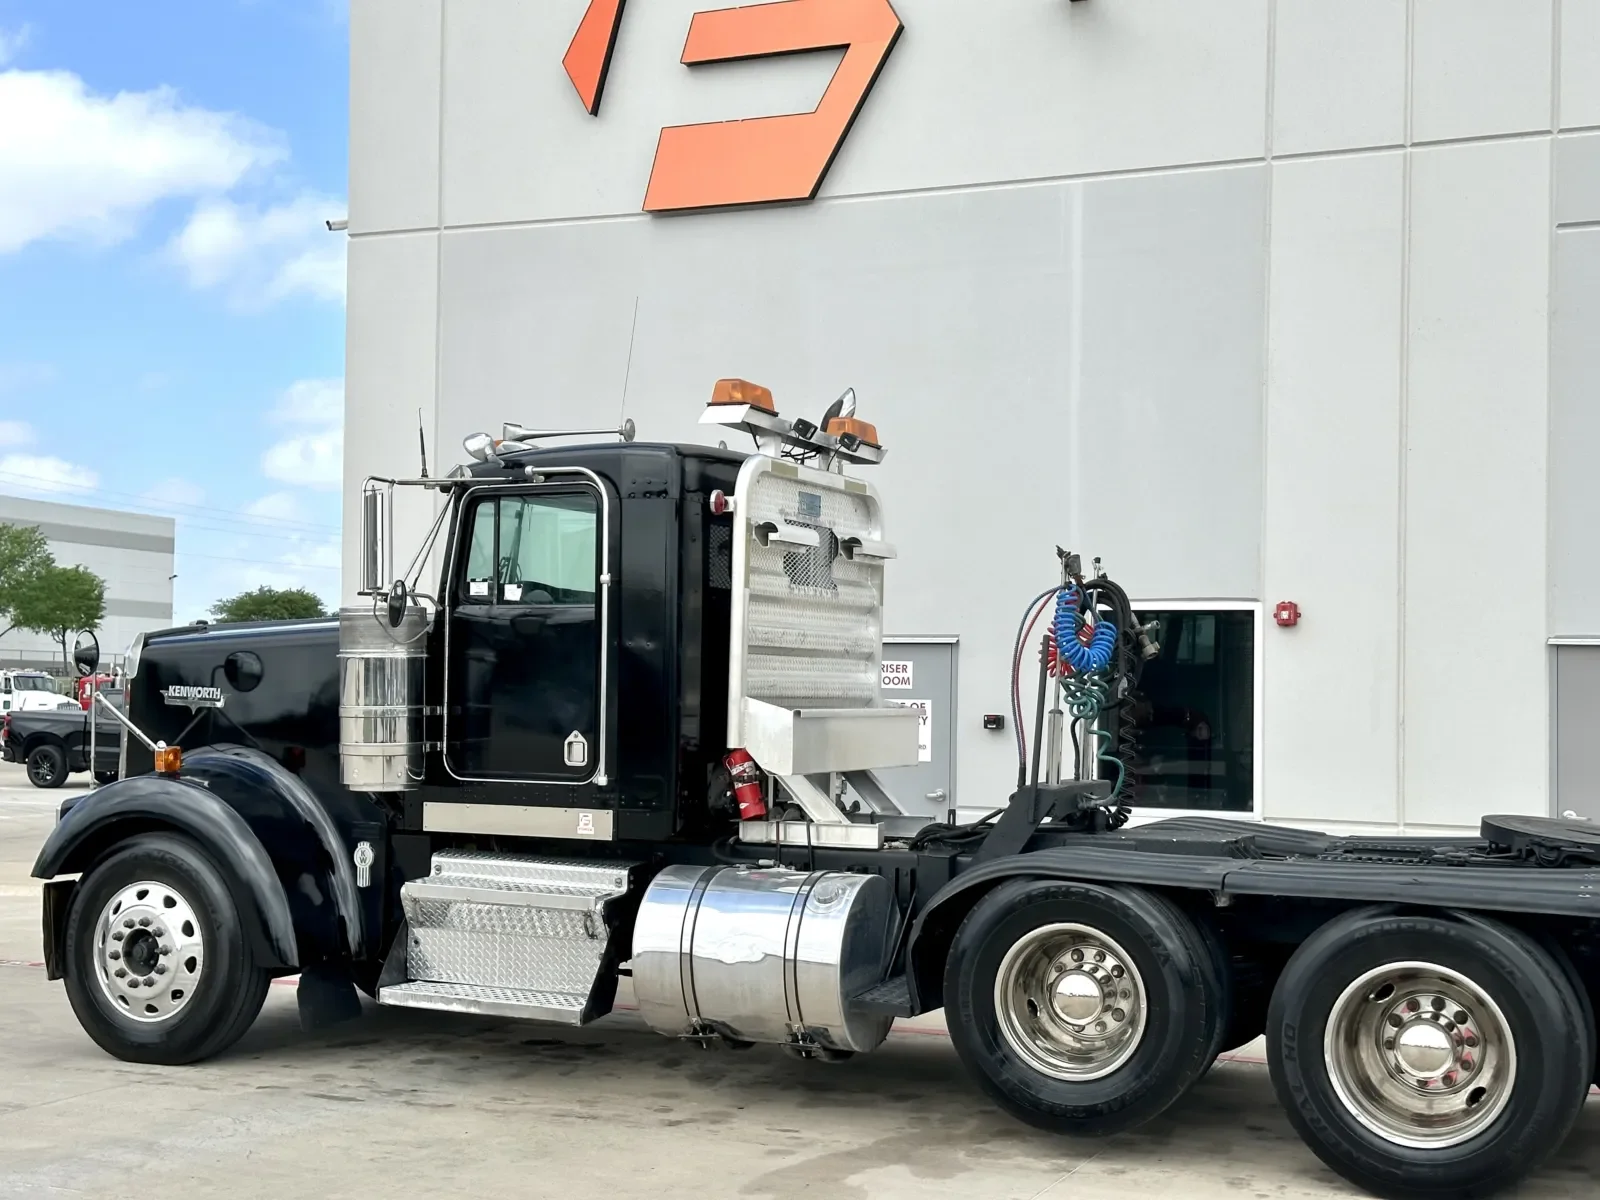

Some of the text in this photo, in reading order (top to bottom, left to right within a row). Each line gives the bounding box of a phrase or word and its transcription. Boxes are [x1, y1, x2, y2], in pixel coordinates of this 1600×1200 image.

[881, 663, 908, 674] RISER
[882, 676, 911, 686] OOM
[168, 685, 221, 699] KENWORTH
